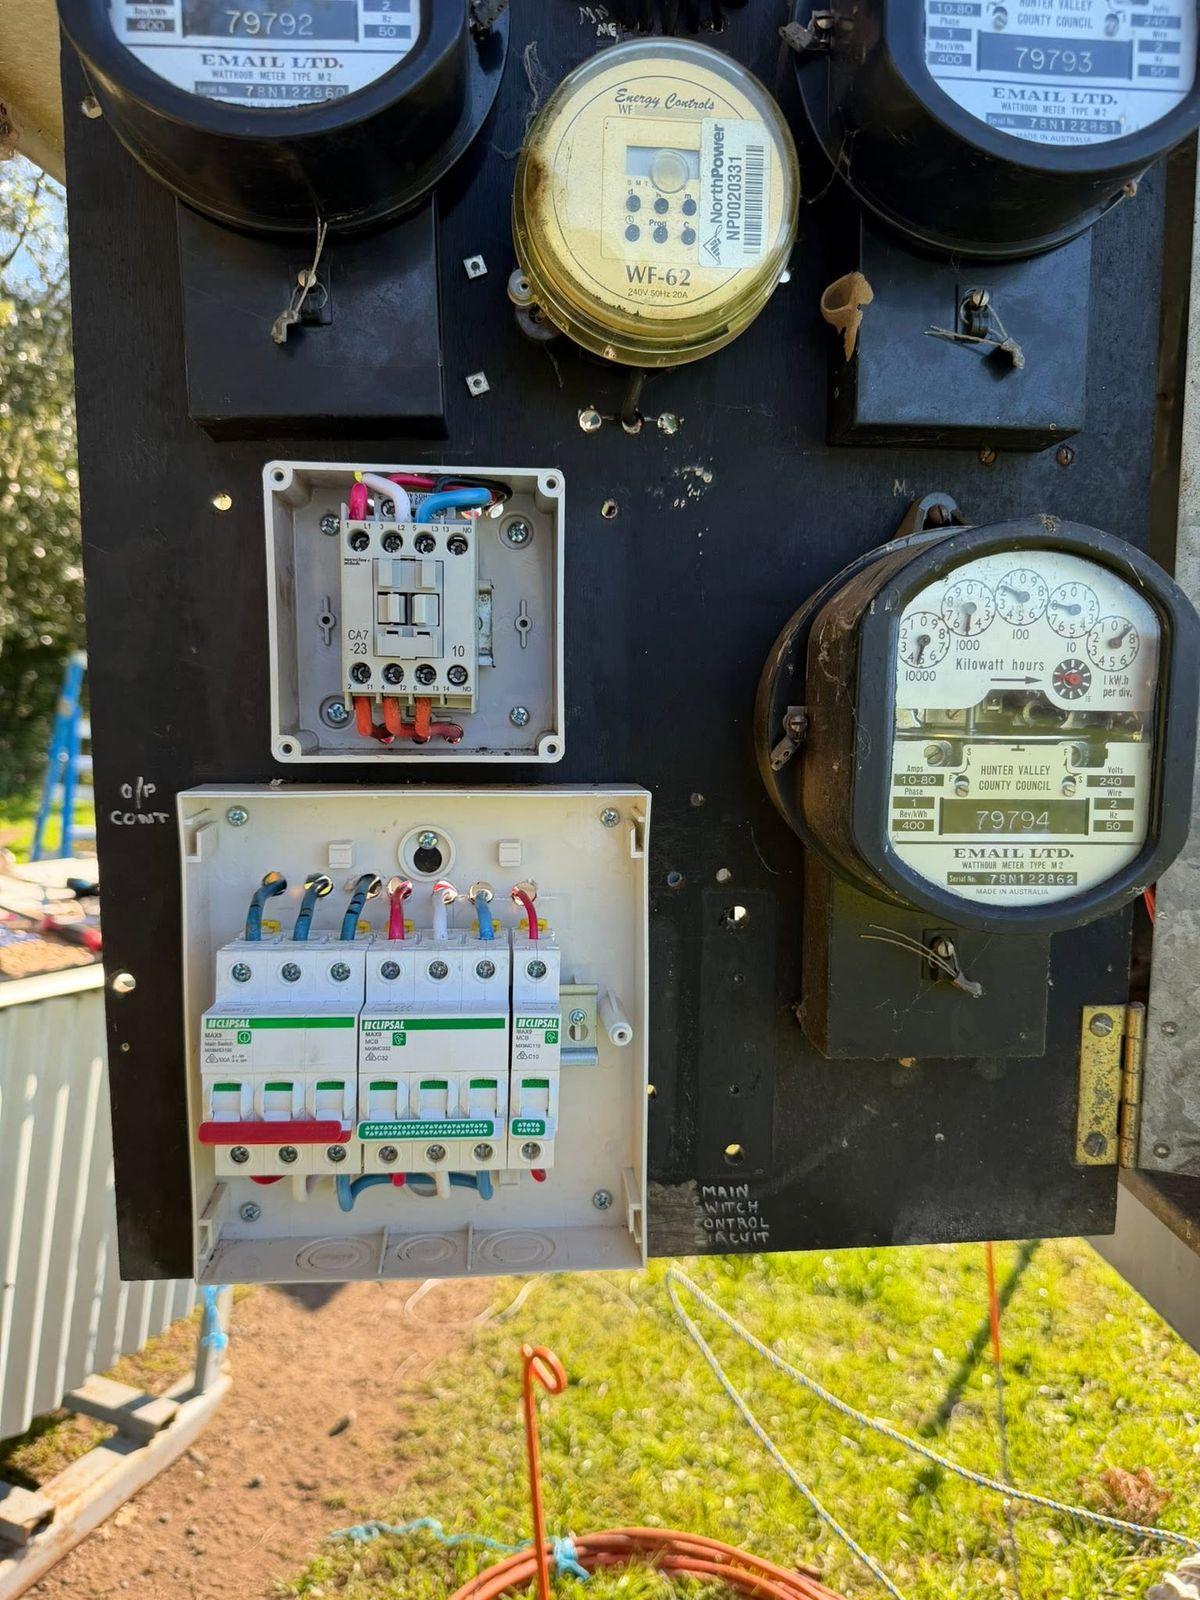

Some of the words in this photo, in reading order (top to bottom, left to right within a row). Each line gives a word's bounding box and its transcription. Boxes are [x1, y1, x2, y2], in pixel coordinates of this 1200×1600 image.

[382, 1, 391, 11] 2
[225, 10, 314, 35] 79792
[1018, 14, 1051, 25] COUNTY
[1056, 16, 1093, 29] COUNCIL
[379, 27, 396, 37] 50
[201, 55, 284, 68] EMAIL
[292, 57, 343, 69] LTD.
[938, 55, 962, 64] 400
[1015, 47, 1093, 73] 79793
[212, 70, 253, 79] WATTHOUR
[260, 71, 285, 81] METER
[293, 72, 311, 81] TYPE
[615, 88, 660, 108] Energy
[665, 93, 714, 109] Controls
[992, 87, 1065, 103] EMAIL
[1071, 92, 1118, 105] LTD.
[619, 104, 633, 114] WF
[1001, 103, 1037, 112] WATTHOUR
[1042, 105, 1066, 114] METER
[1072, 107, 1088, 116] TYPE
[710, 124, 725, 224] NorthPower
[727, 155, 742, 240] NP0020331
[626, 265, 690, 286] WF-62
[628, 288, 648, 296] 240V
[348, 630, 368, 640] CA7
[1012, 629, 1029, 640] 100
[349, 643, 367, 655] -23
[956, 640, 980, 651] 1000
[1066, 642, 1076, 653] 10
[451, 645, 465, 657] 10
[955, 658, 1004, 671] Kilowatt
[1012, 659, 1045, 672] hours
[905, 671, 936, 681] 10000
[1103, 689, 1116, 698] per
[1119, 688, 1132, 697] div.
[906, 765, 924, 774] Amps
[981, 765, 1013, 776] HUNTER
[1018, 765, 1051, 776] VALLEY
[1108, 766, 1123, 774] Volts
[901, 775, 936, 785] 10-80
[1099, 777, 1121, 786] 240
[978, 780, 1012, 791] COUNTY
[1016, 780, 1051, 791] COUNCIL
[904, 787, 923, 796] Phase
[1107, 789, 1122, 797] Wire
[1111, 800, 1117, 808] 2
[111, 810, 170, 825] CONT
[899, 810, 928, 819] Rev/kWh
[1109, 811, 1118, 819] Hz
[902, 821, 924, 830] 400
[976, 811, 1050, 831] 79794
[1106, 822, 1121, 831] 50
[954, 848, 1024, 859] EMAIL
[1029, 848, 1074, 859] LTD.
[962, 861, 997, 870] WATTHOUR
[1002, 861, 1024, 870] METER
[1030, 861, 1046, 870] TYPE
[949, 875, 966, 884] Serial
[967, 875, 976, 883] No.
[989, 874, 1074, 884] 78N122862
[372, 1021, 404, 1029] CLIPSAL
[526, 1019, 557, 1027] CLIPSAL
[702, 1184, 748, 1198] MAIN
